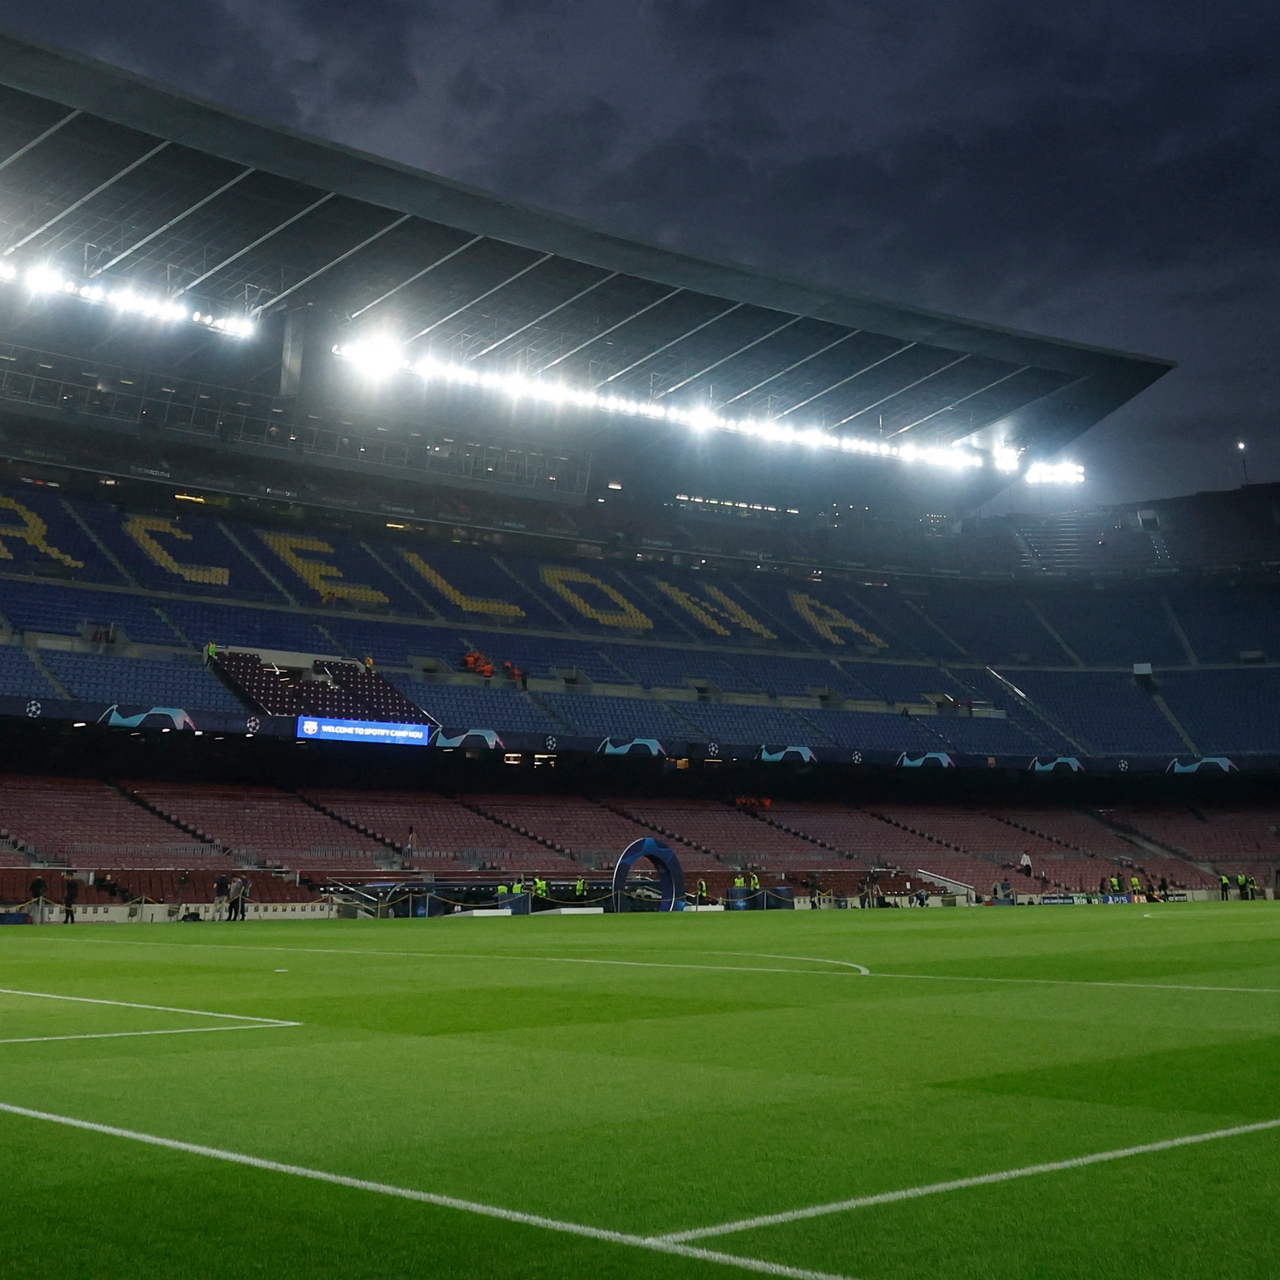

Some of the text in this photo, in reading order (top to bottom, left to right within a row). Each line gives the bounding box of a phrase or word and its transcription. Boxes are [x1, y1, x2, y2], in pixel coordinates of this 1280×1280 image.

[322, 725, 354, 734] WELCOME
[355, 727, 364, 735] TO
[364, 728, 390, 736] SPOTIFY
[390, 729, 408, 737] CAMP
